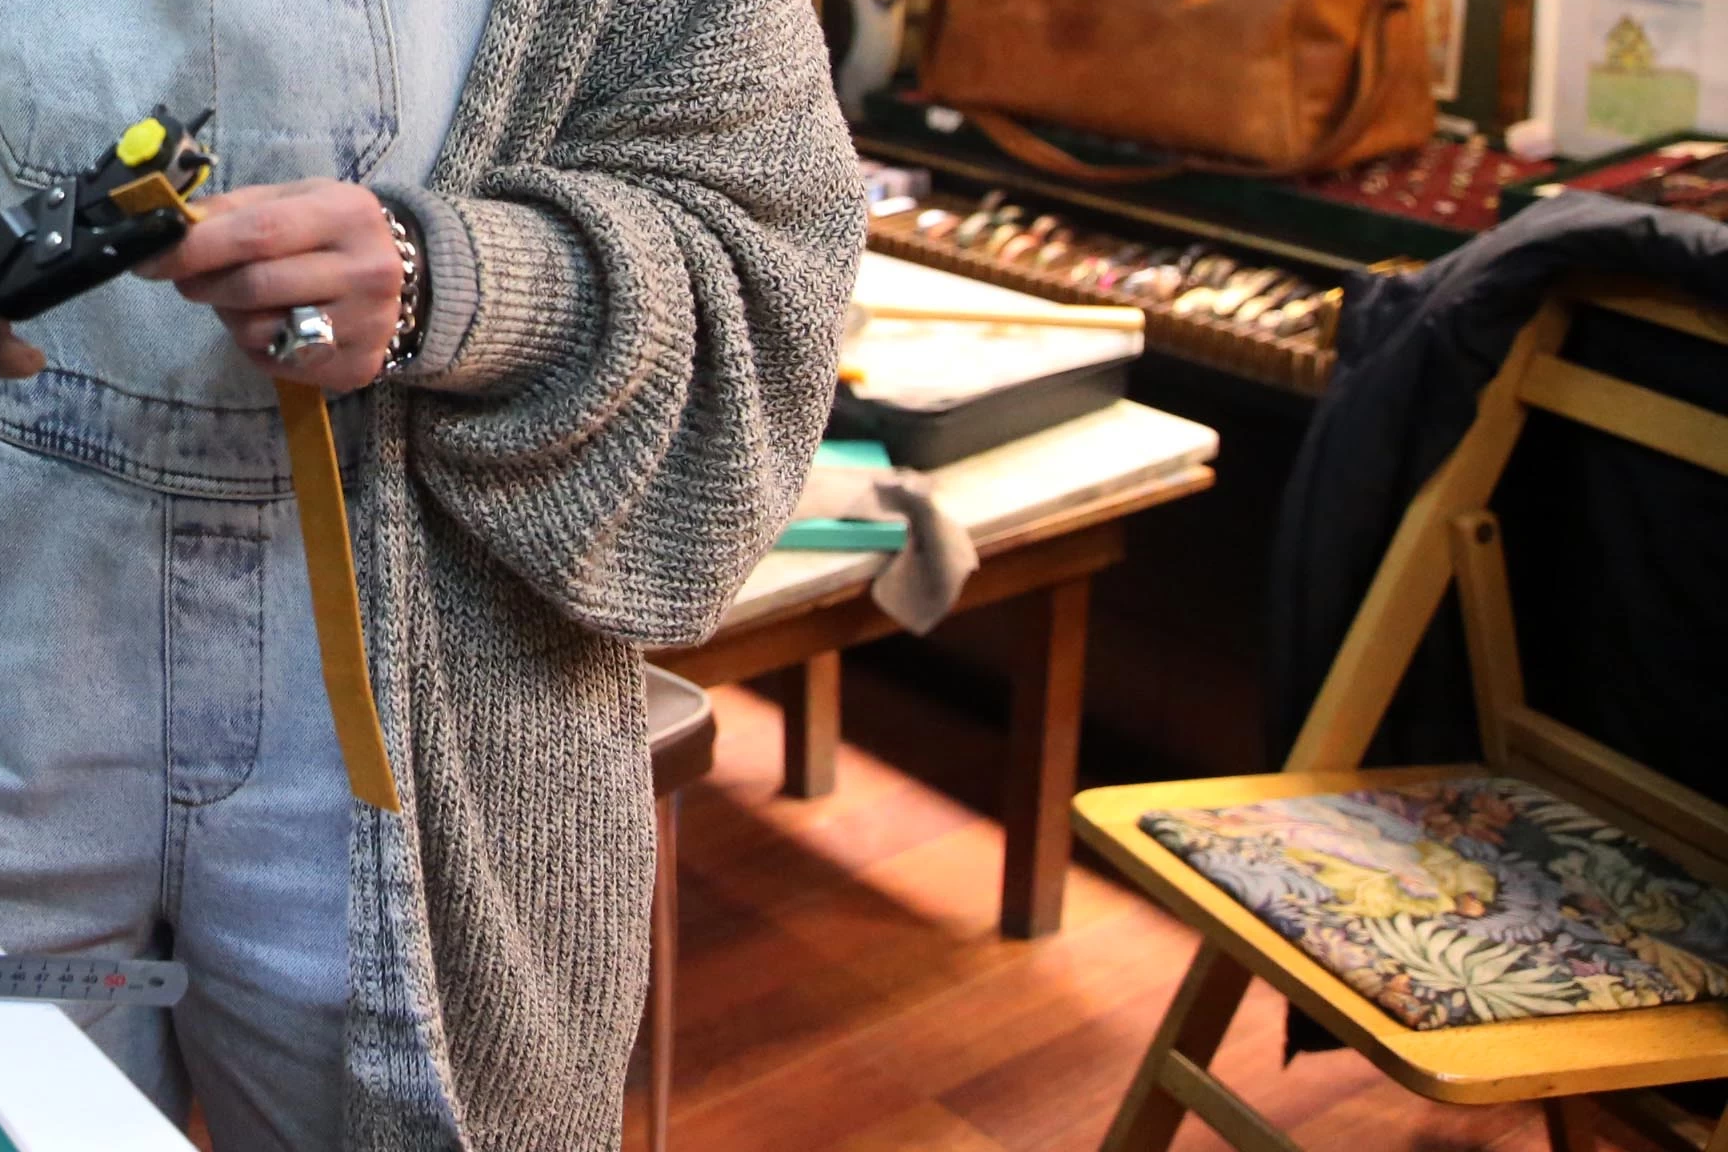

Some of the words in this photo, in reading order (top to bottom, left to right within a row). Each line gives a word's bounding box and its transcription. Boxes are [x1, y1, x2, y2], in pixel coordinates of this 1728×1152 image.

[34, 972, 50, 982] 47
[58, 973, 74, 983] 48
[82, 974, 98, 984] 49
[104, 973, 127, 987] 50
